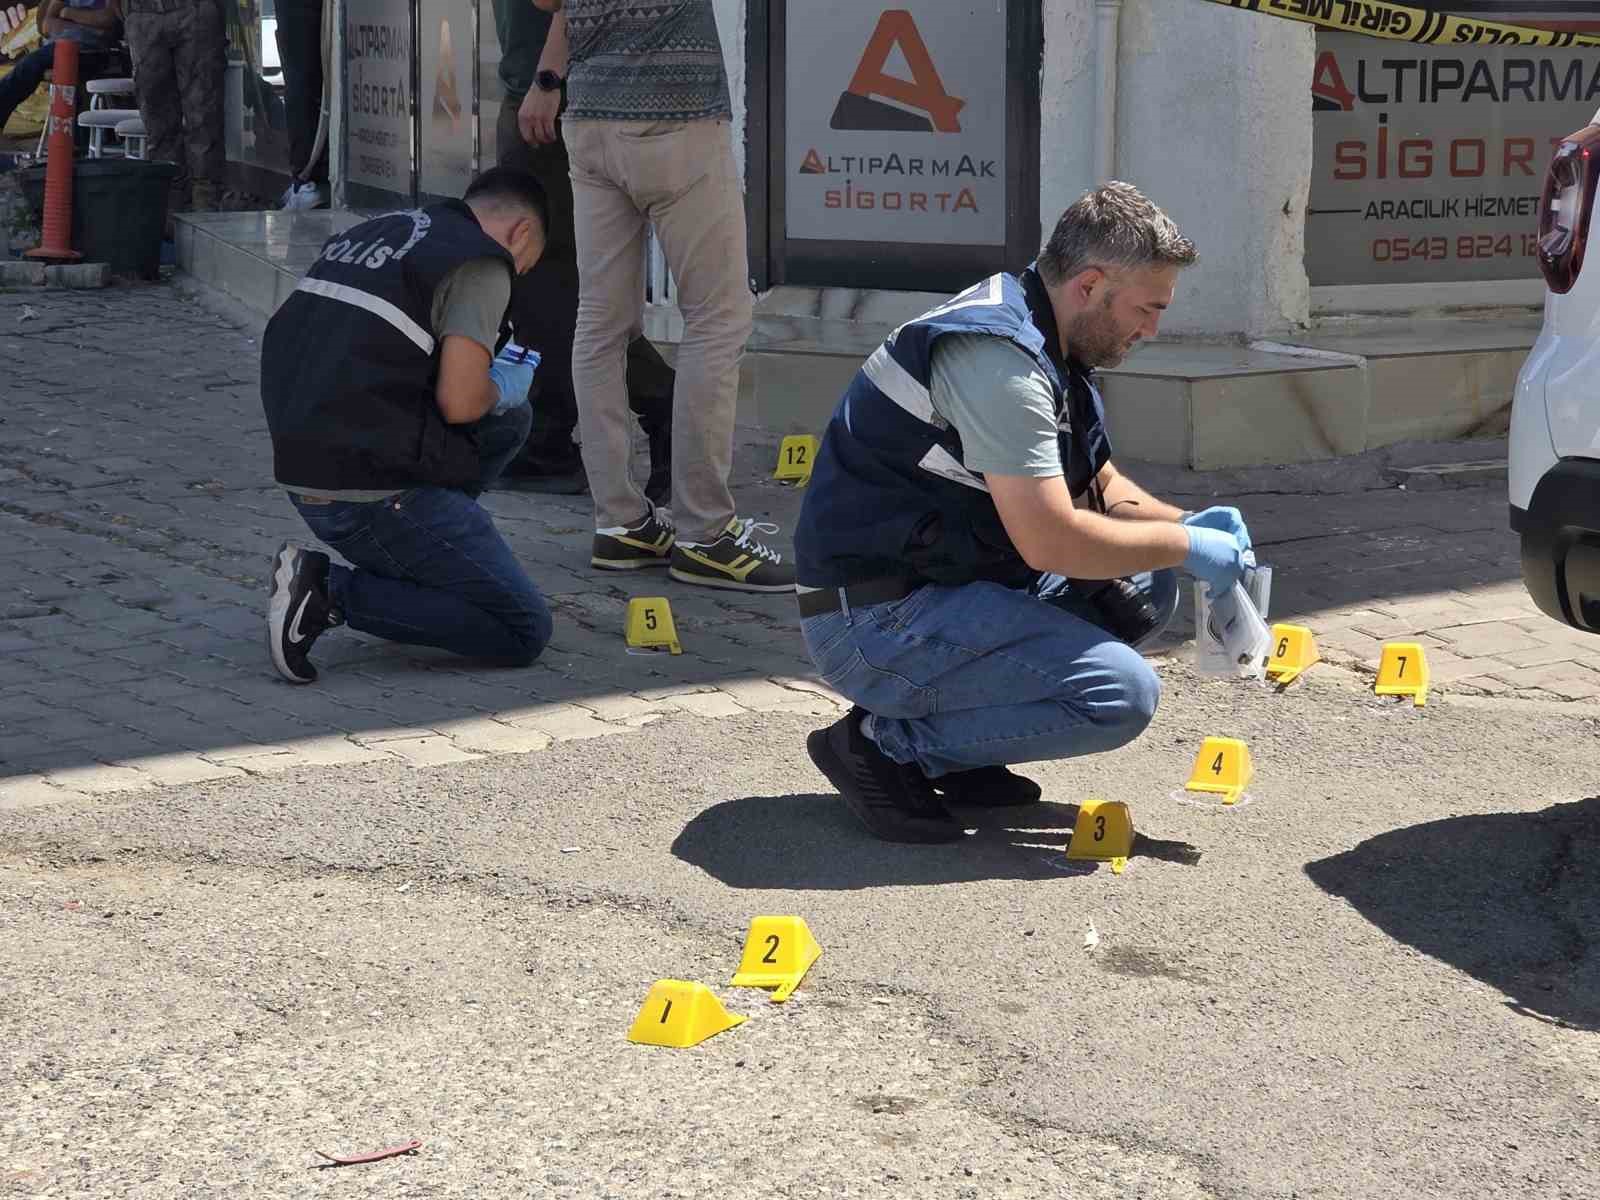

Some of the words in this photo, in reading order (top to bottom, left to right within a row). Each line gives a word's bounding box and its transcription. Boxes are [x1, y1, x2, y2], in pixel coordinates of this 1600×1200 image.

[1333, 113, 1564, 180] SİGOR
[798, 148, 996, 178] ALTIPARMAK
[824, 179, 979, 213] SİGORTA
[1364, 199, 1459, 220] ARACILIK
[1372, 236, 1448, 261] 0543
[1457, 234, 1513, 258] 824
[786, 446, 806, 465] 12
[644, 609, 657, 631] 5
[1276, 637, 1288, 658] 6
[1397, 656, 1408, 679] 7
[1211, 752, 1224, 775] 4
[1094, 815, 1106, 841] 3
[762, 934, 780, 964] 2
[659, 998, 673, 1024] 1
